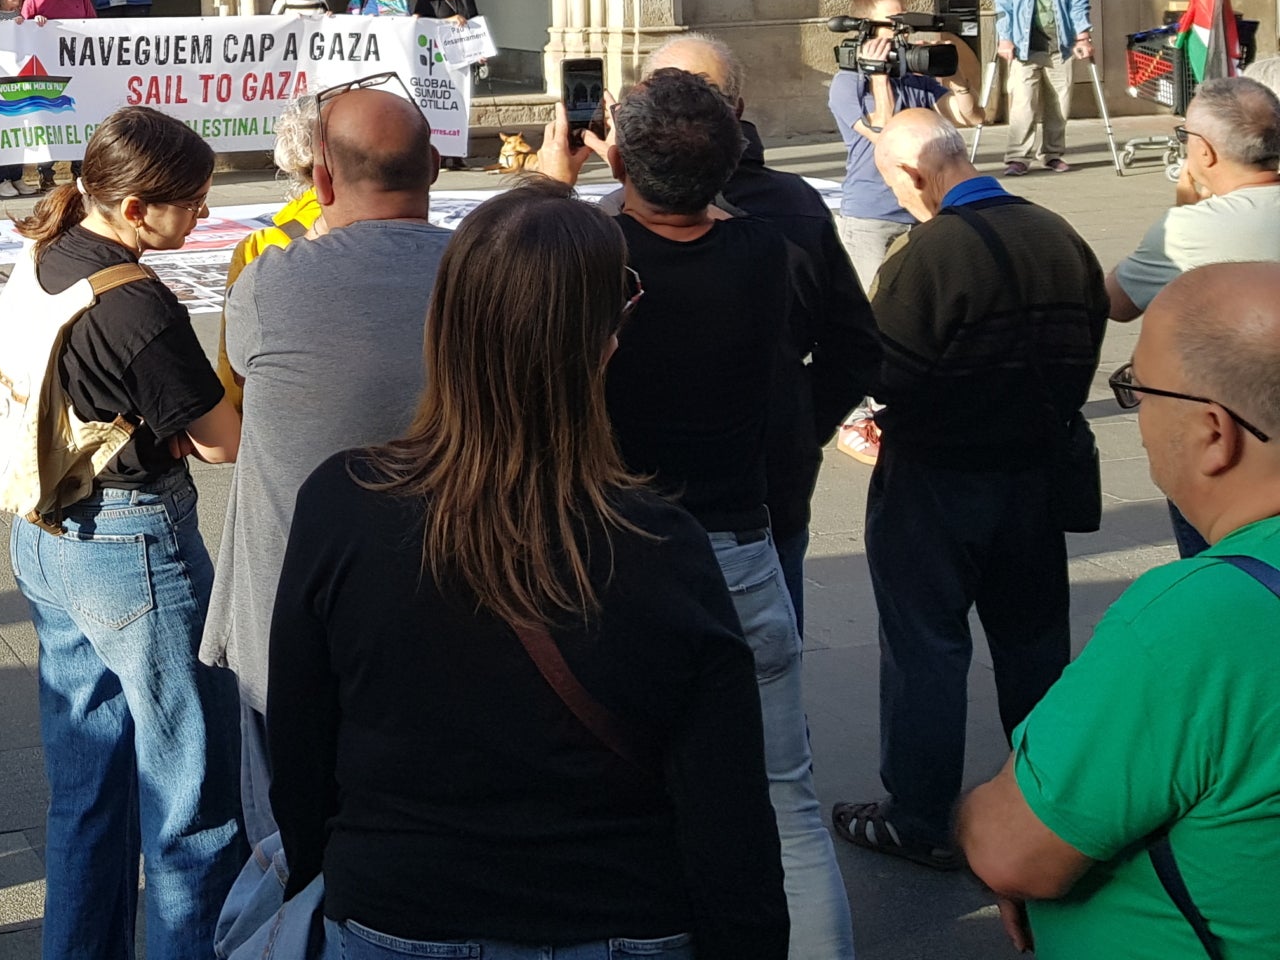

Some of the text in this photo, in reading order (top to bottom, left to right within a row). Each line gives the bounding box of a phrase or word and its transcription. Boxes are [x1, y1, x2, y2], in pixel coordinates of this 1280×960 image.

[59, 31, 381, 67] NAVEGUEM CAP A GAZA
[127, 71, 308, 105] SAIL TO GAZA
[410, 77, 455, 90] GLOBAL
[414, 88, 451, 100] SUMUD
[420, 99, 459, 111] OTILLA
[0, 125, 63, 150] ATUREM
[66, 125, 82, 144] EL
